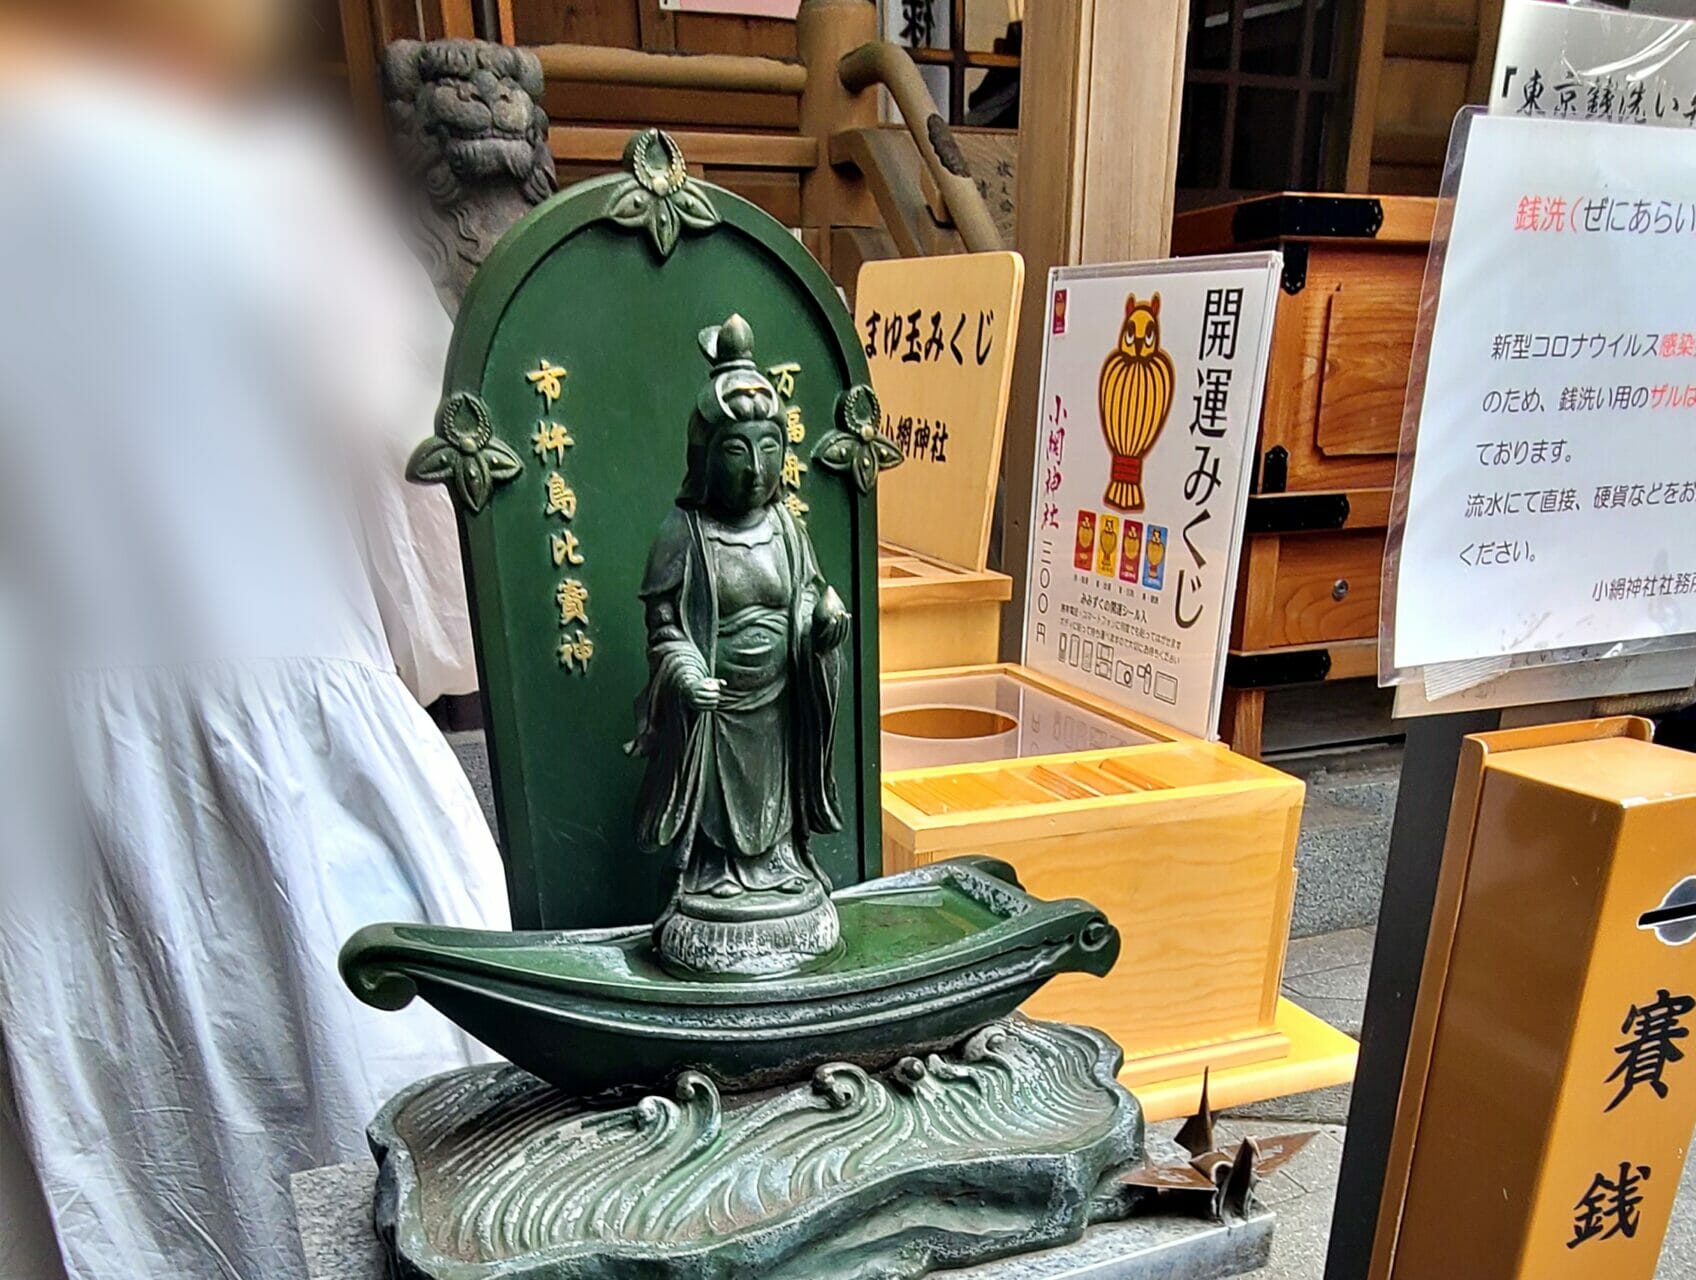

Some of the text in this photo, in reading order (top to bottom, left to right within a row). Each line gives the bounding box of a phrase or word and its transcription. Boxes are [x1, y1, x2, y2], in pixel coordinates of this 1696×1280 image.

[865, 309, 994, 366] まゆ玉みくじ
[1491, 332, 1696, 360] 新型コロナウイルス感染
[1175, 287, 1244, 629] 開運みくじ
[1476, 438, 1572, 466] ております。
[1459, 540, 1536, 566] ください。
[1566, 988, 1696, 1250] 賽銭
